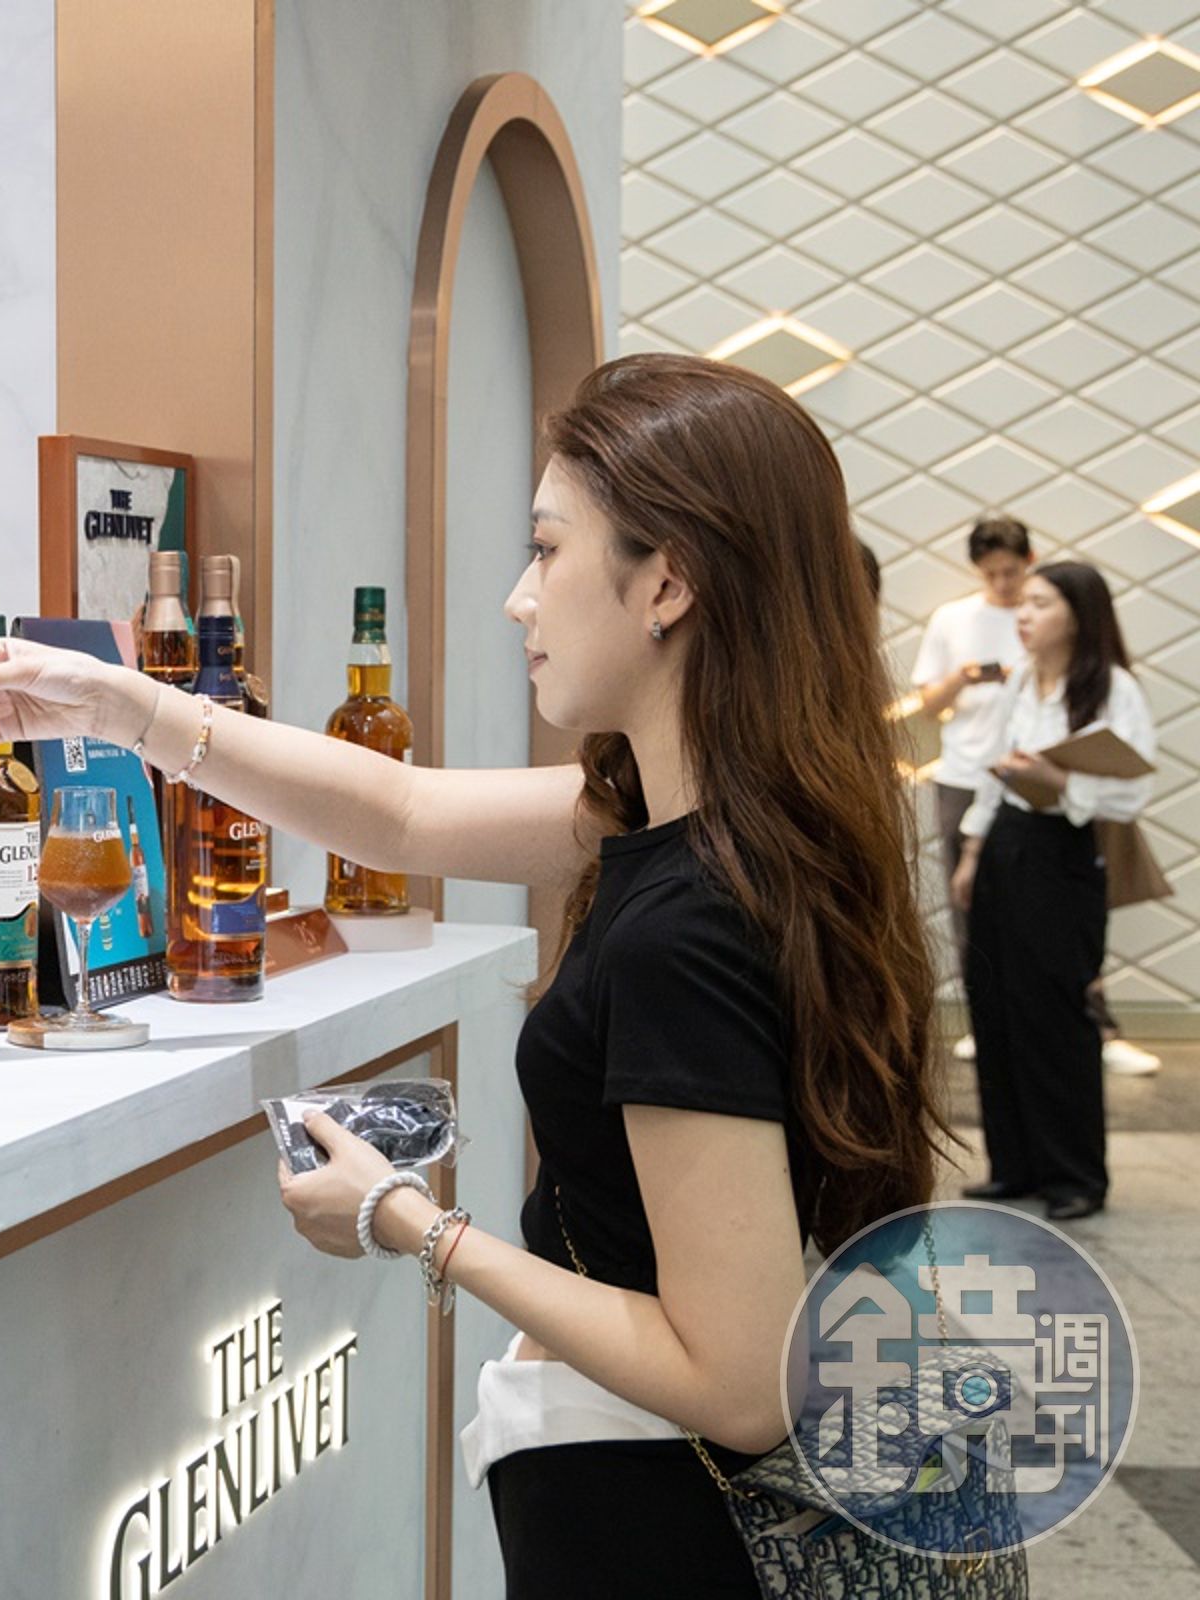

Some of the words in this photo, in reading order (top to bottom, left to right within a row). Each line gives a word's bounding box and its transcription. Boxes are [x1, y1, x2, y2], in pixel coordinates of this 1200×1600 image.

[84, 510, 155, 545] GLENLIVET
[109, 489, 133, 511] THE
[212, 1302, 284, 1417] THE
[109, 1335, 359, 1600] GLENLIVET
